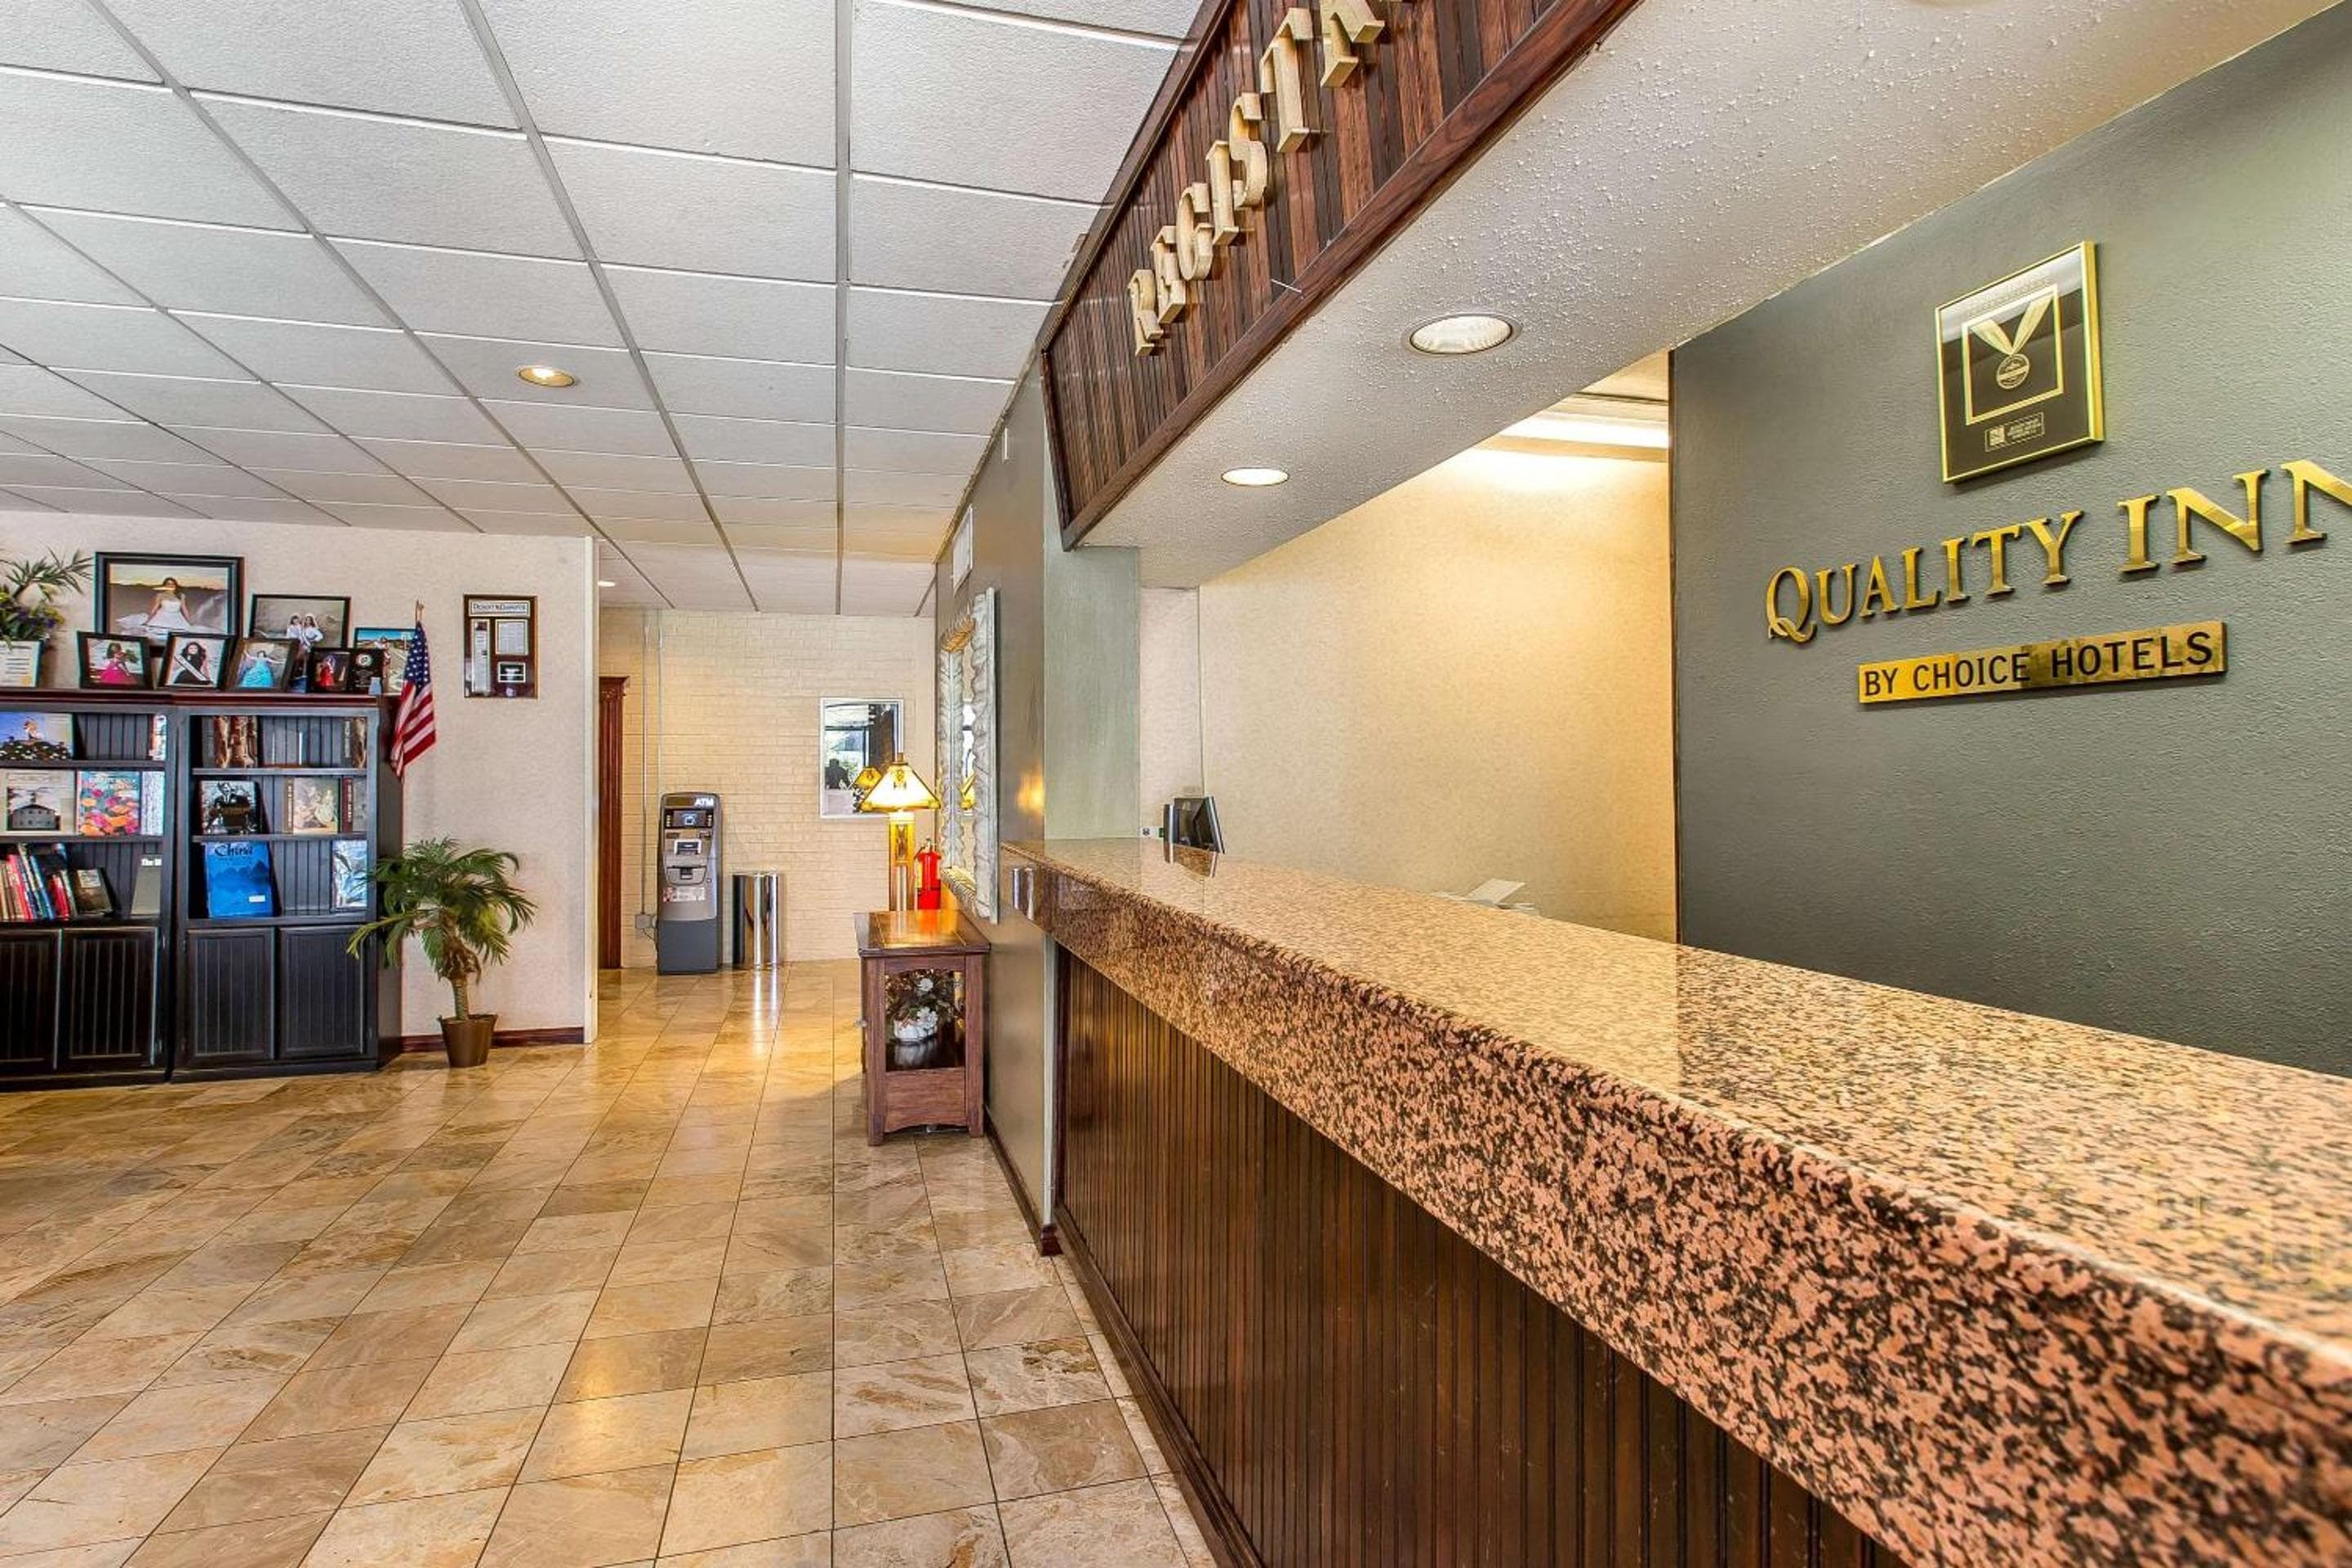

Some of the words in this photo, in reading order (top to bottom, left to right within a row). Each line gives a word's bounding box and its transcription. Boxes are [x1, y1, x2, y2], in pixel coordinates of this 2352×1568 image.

[1766, 510, 2085, 643] QUALITY
[2118, 459, 2352, 576] INN
[1864, 670, 1901, 697] BY
[1913, 650, 2030, 689] CHOICE
[2051, 630, 2213, 679] HOTELS
[694, 797, 715, 808] ATM
